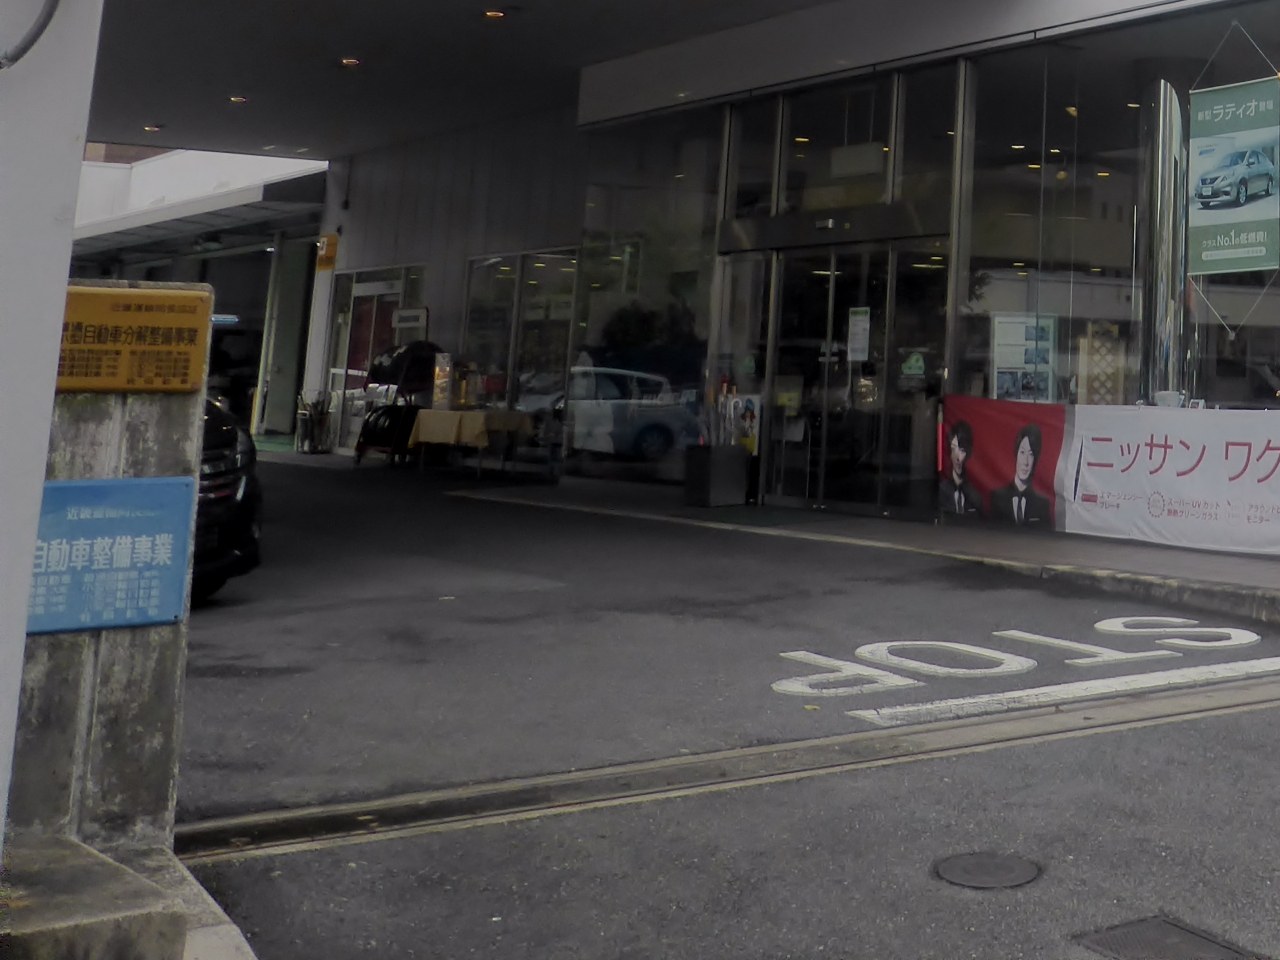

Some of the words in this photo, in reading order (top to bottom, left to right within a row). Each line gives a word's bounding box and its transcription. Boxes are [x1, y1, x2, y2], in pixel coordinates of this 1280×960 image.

[1086, 433, 1206, 480] ニッサン
[770, 616, 1262, 697] STOP
